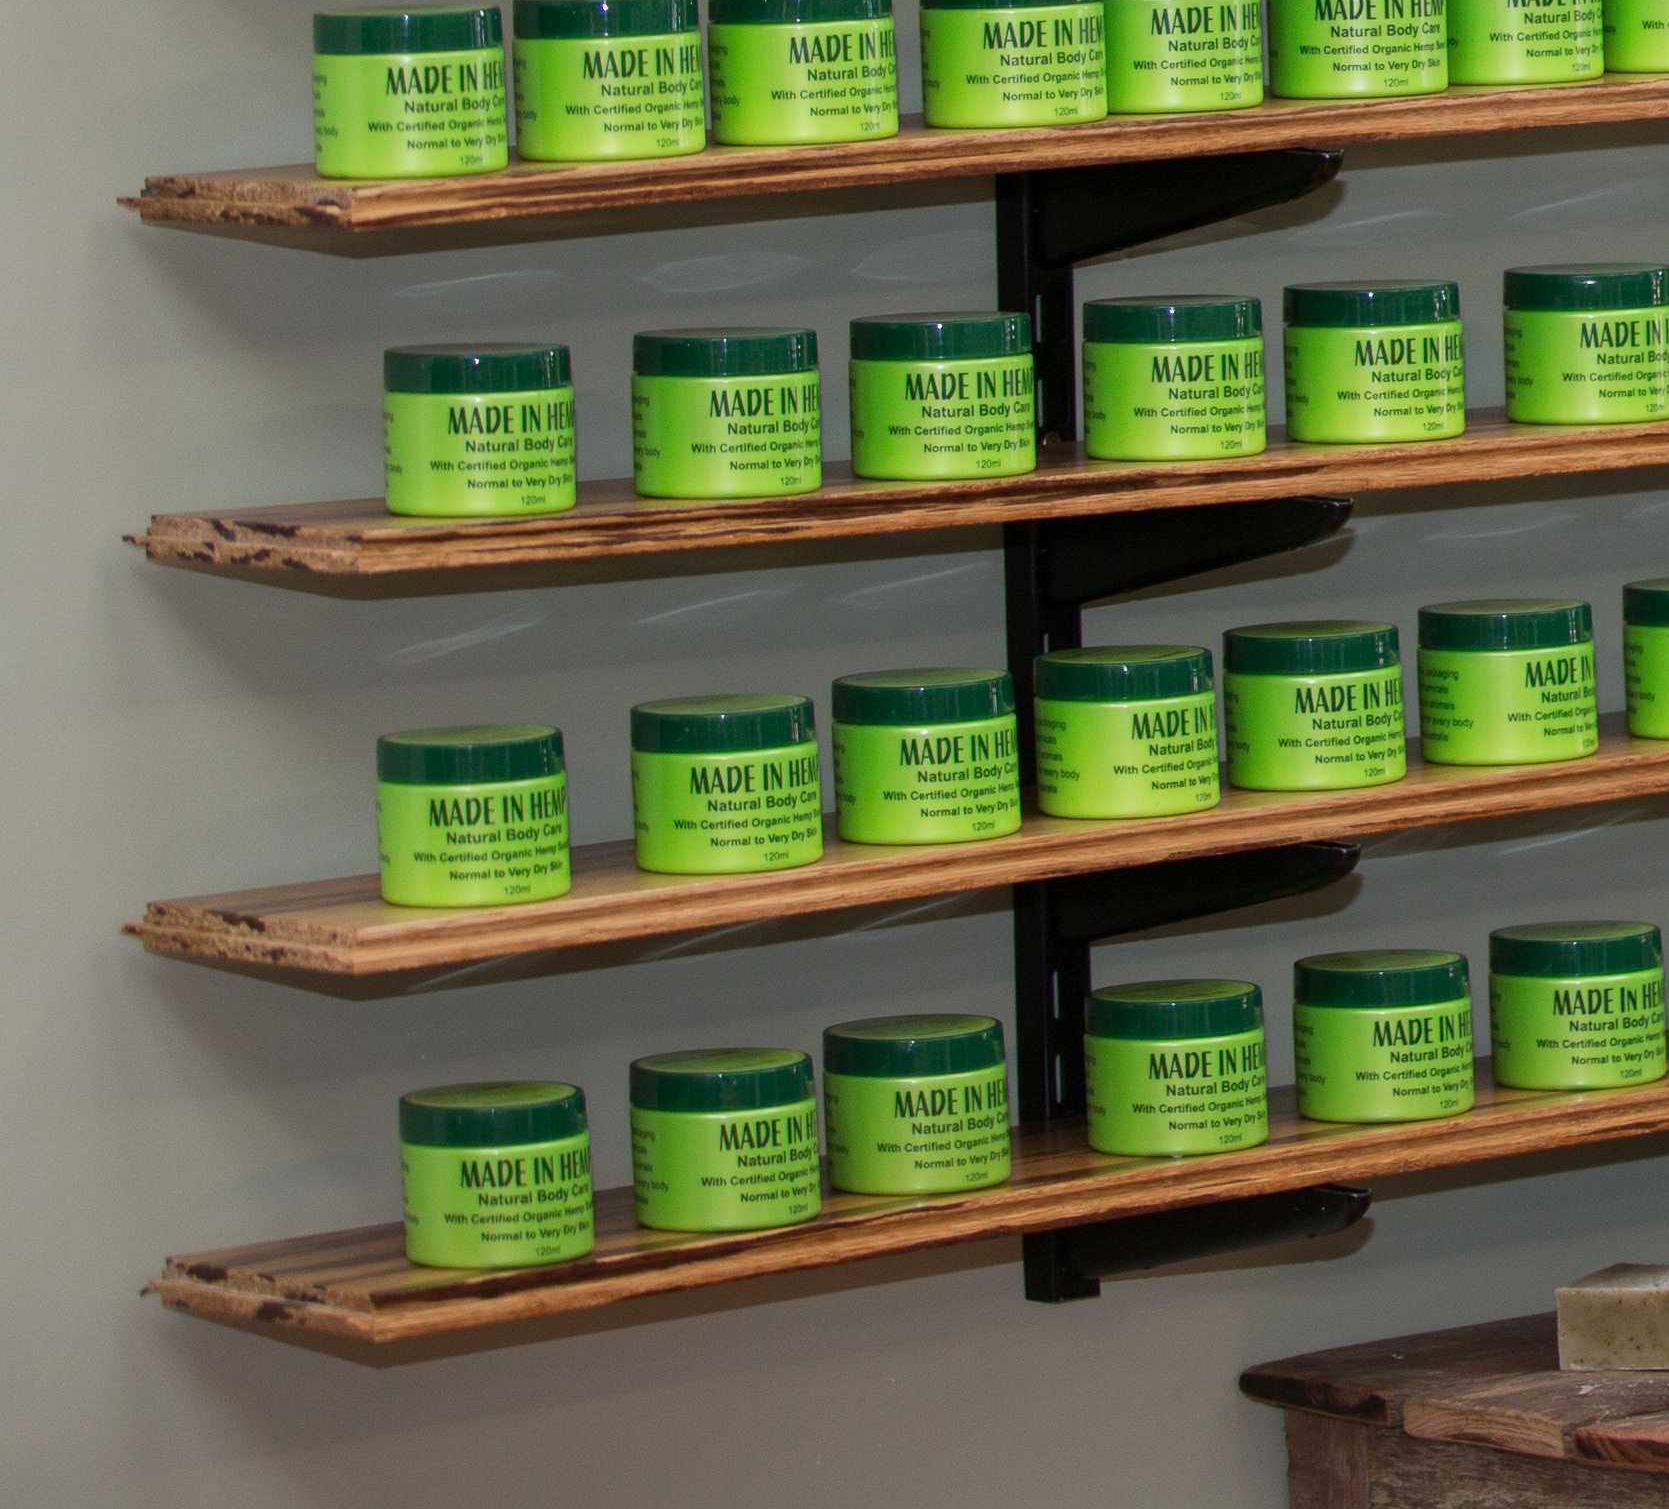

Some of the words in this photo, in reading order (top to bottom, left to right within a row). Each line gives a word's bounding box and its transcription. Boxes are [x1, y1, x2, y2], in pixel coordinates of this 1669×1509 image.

[904, 372, 970, 401] MADE
[976, 371, 997, 400] IN
[429, 795, 497, 828] MADE
[503, 794, 524, 823] IN
[460, 1158, 527, 1188] MADE
[534, 1156, 555, 1186] IN
